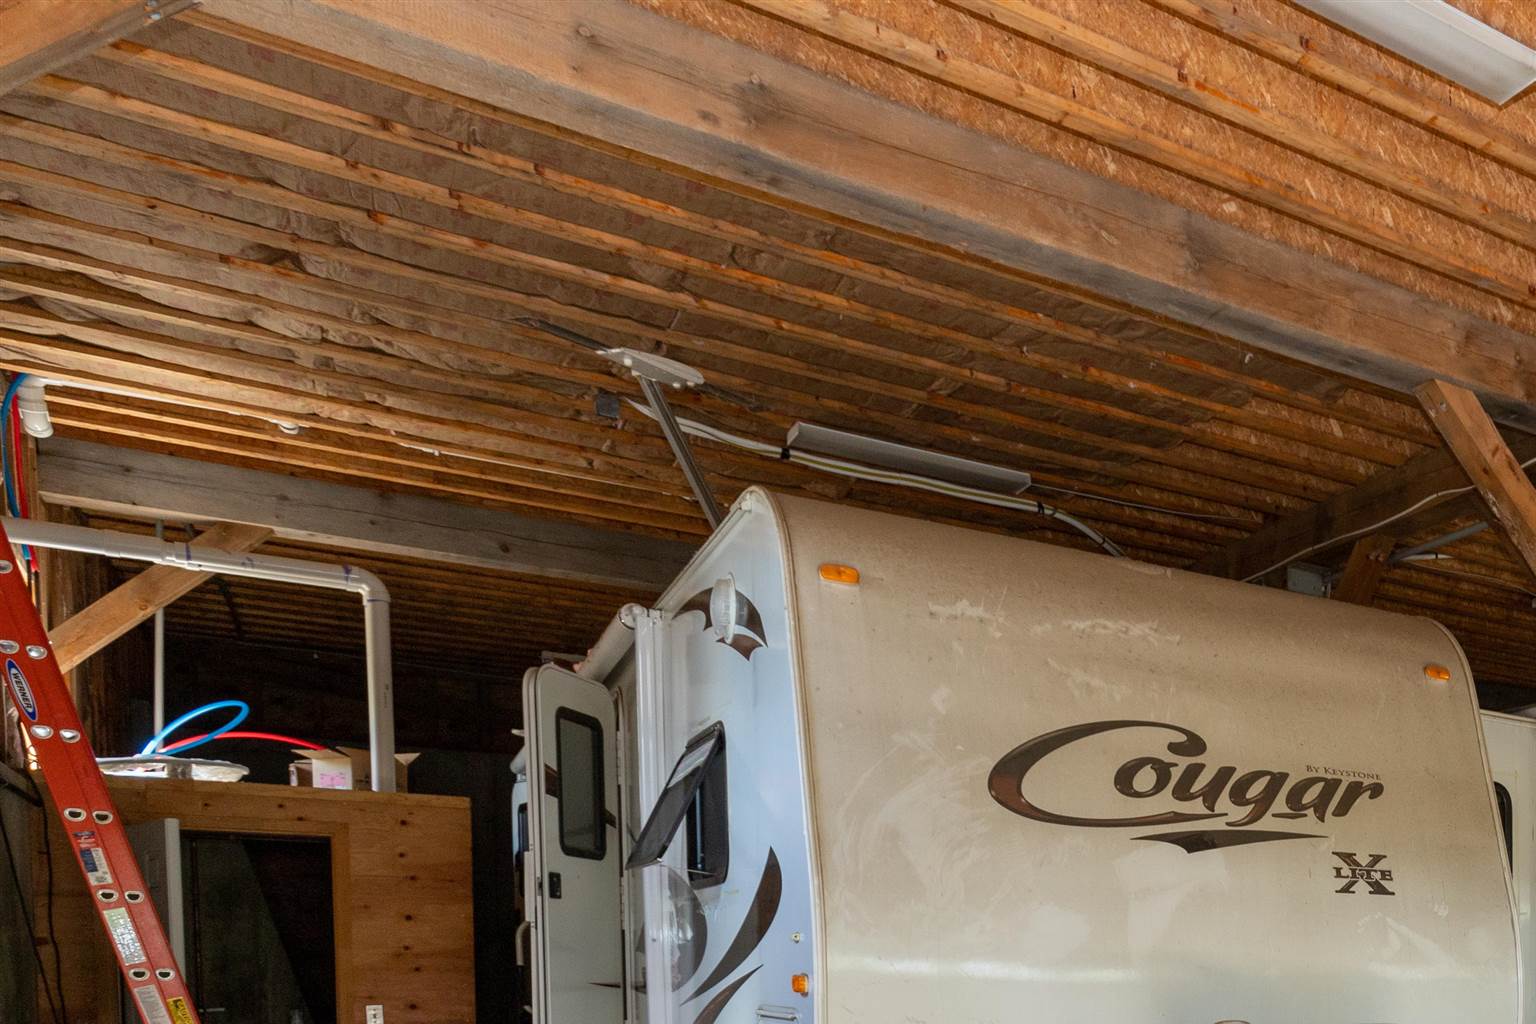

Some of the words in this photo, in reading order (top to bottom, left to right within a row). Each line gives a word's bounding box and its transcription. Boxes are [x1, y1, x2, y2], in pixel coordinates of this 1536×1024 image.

[12, 672, 33, 709] WERNER
[988, 720, 1384, 827] Cougar
[1323, 766, 1382, 781] KEYSTONE
[1332, 867, 1394, 881] LITE
